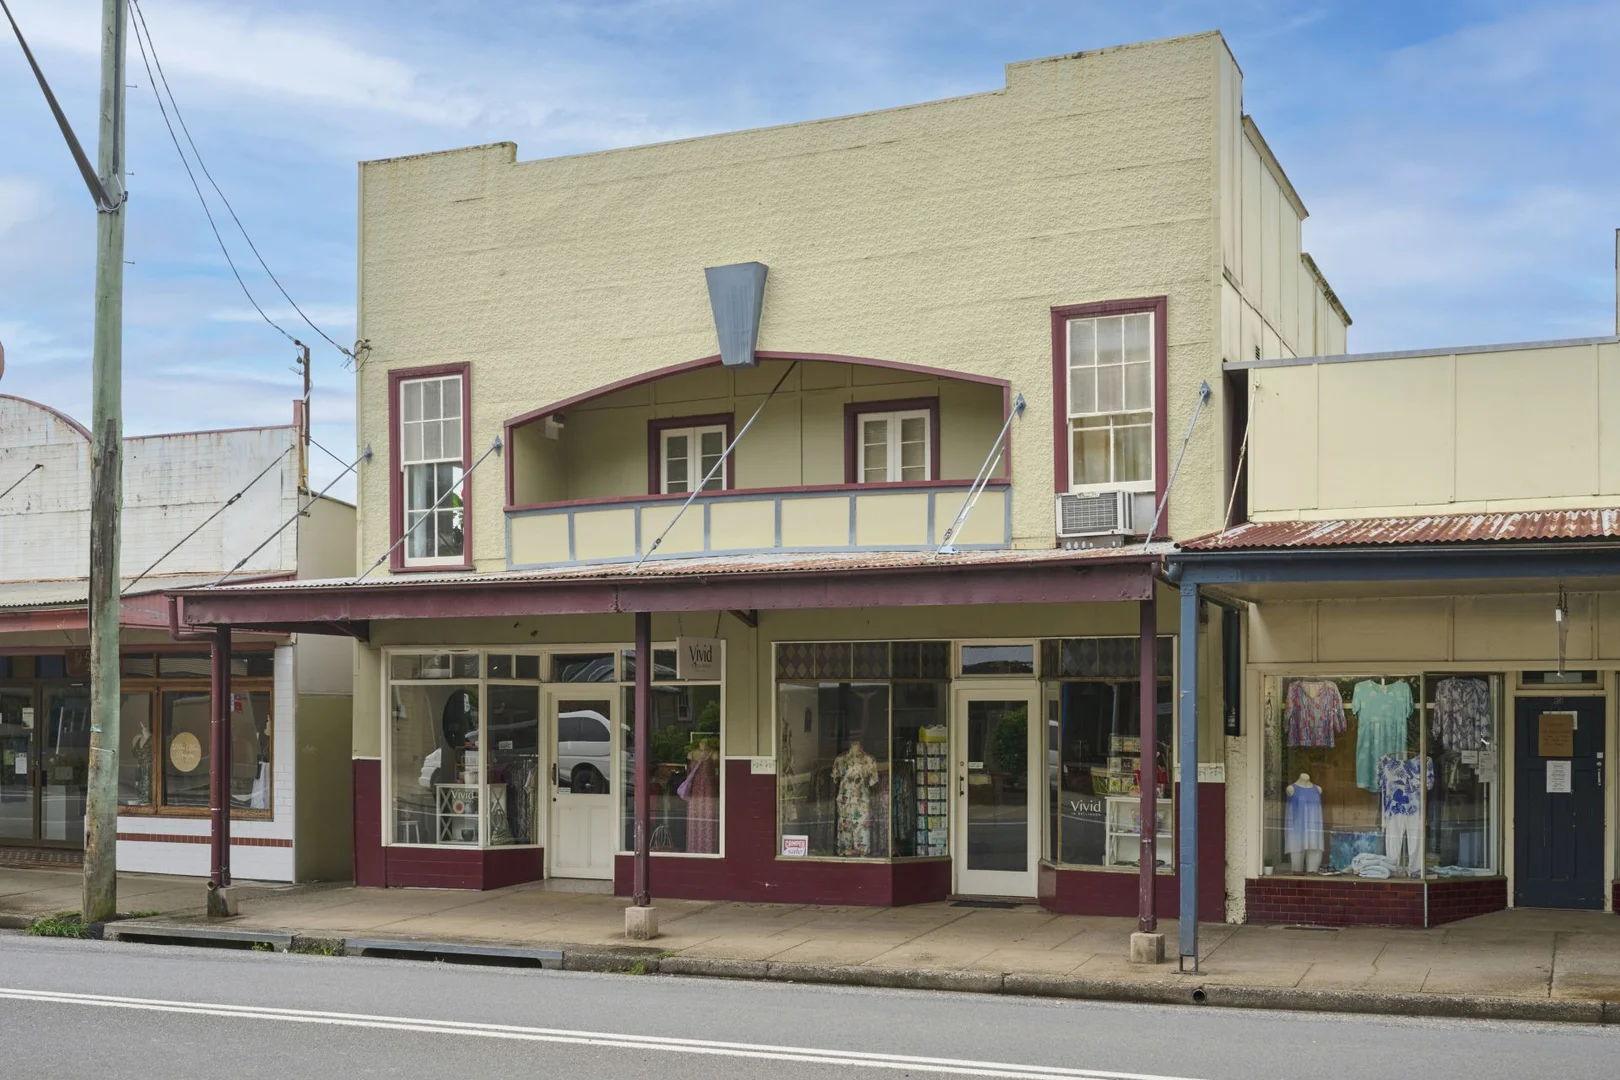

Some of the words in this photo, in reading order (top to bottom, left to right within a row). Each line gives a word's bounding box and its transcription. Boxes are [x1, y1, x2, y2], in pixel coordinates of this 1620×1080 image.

[689, 644, 712, 662] Vivid
[451, 790, 474, 799] Vivid
[1070, 800, 1101, 812] Vivid
